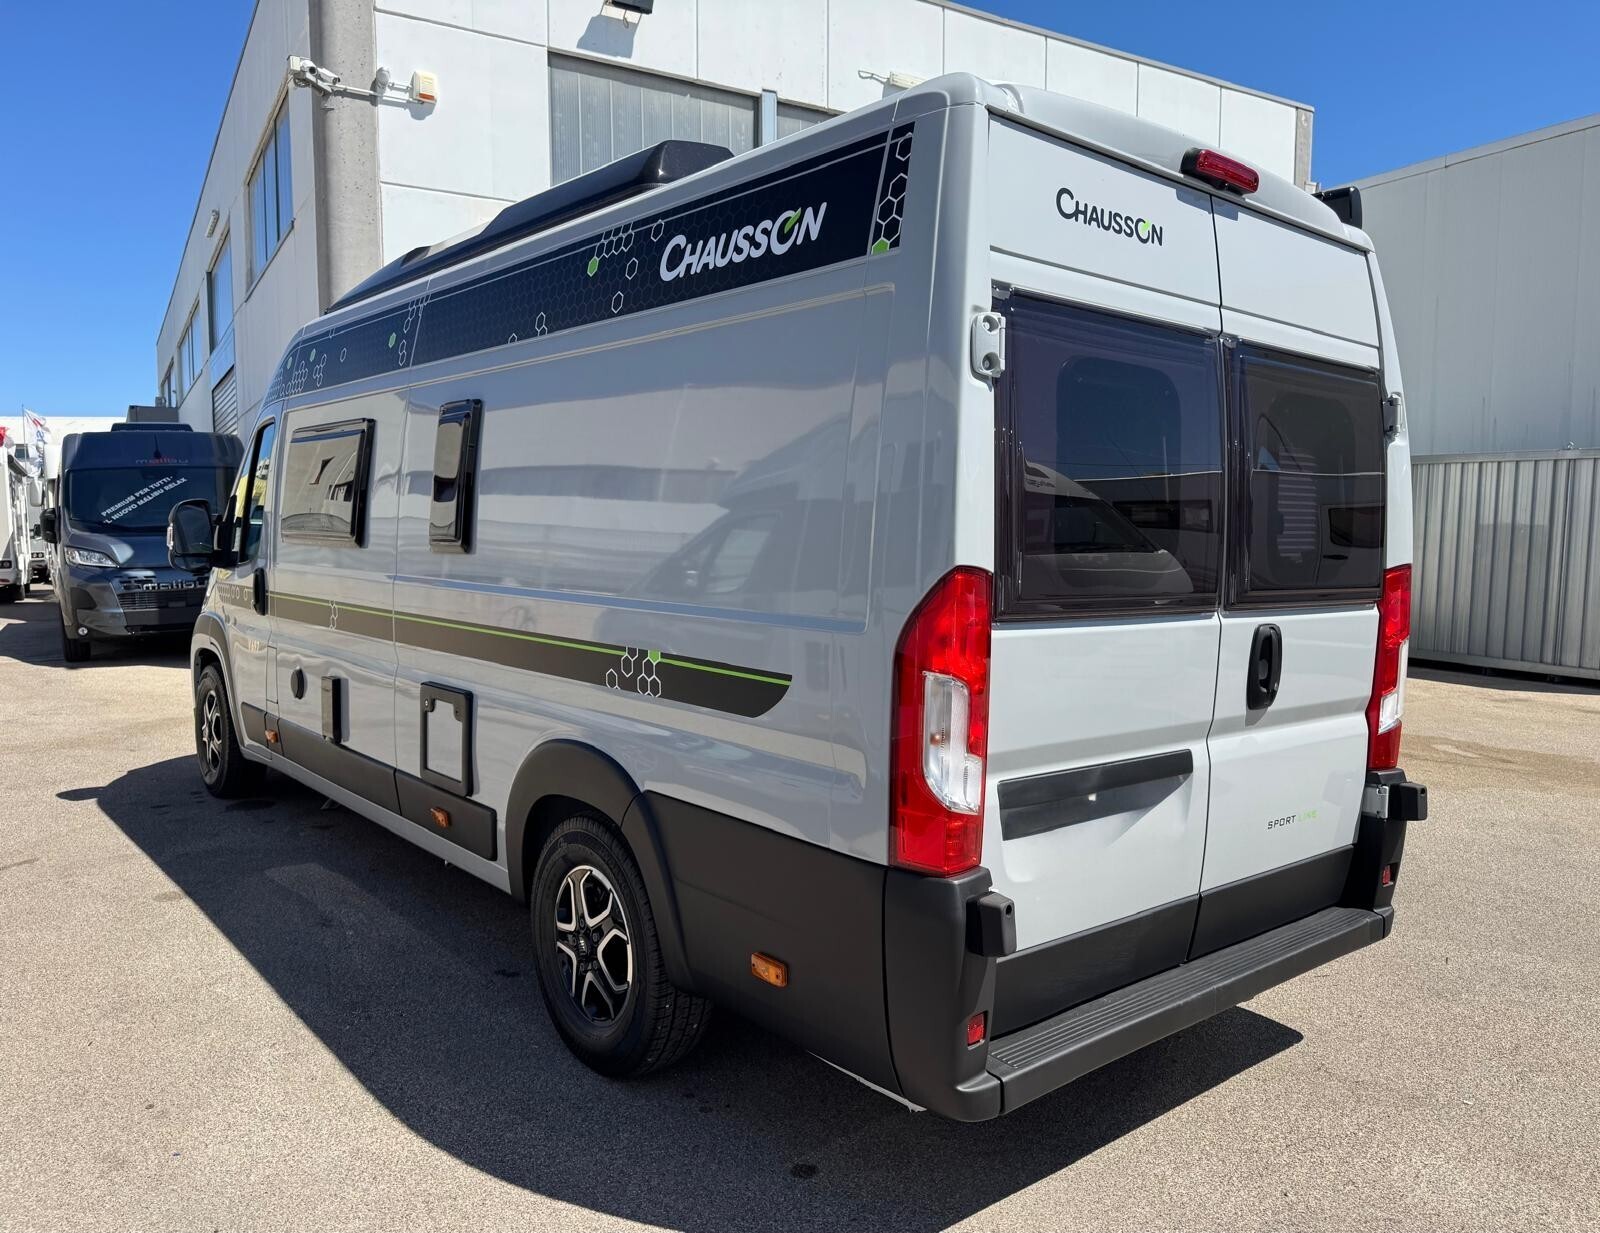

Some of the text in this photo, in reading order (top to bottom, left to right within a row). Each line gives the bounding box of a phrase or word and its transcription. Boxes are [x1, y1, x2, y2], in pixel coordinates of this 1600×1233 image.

[1056, 187, 1163, 247] CHAUSSON
[659, 202, 828, 282] CHAUSSON
[101, 495, 136, 517] PREMIUM
[134, 486, 151, 498] PER
[111, 504, 138, 520] NUOVO
[137, 489, 165, 506] MALIBU
[163, 477, 188, 491] RELAX
[143, 580, 208, 591] malibu
[1267, 814, 1297, 830] SPORT
